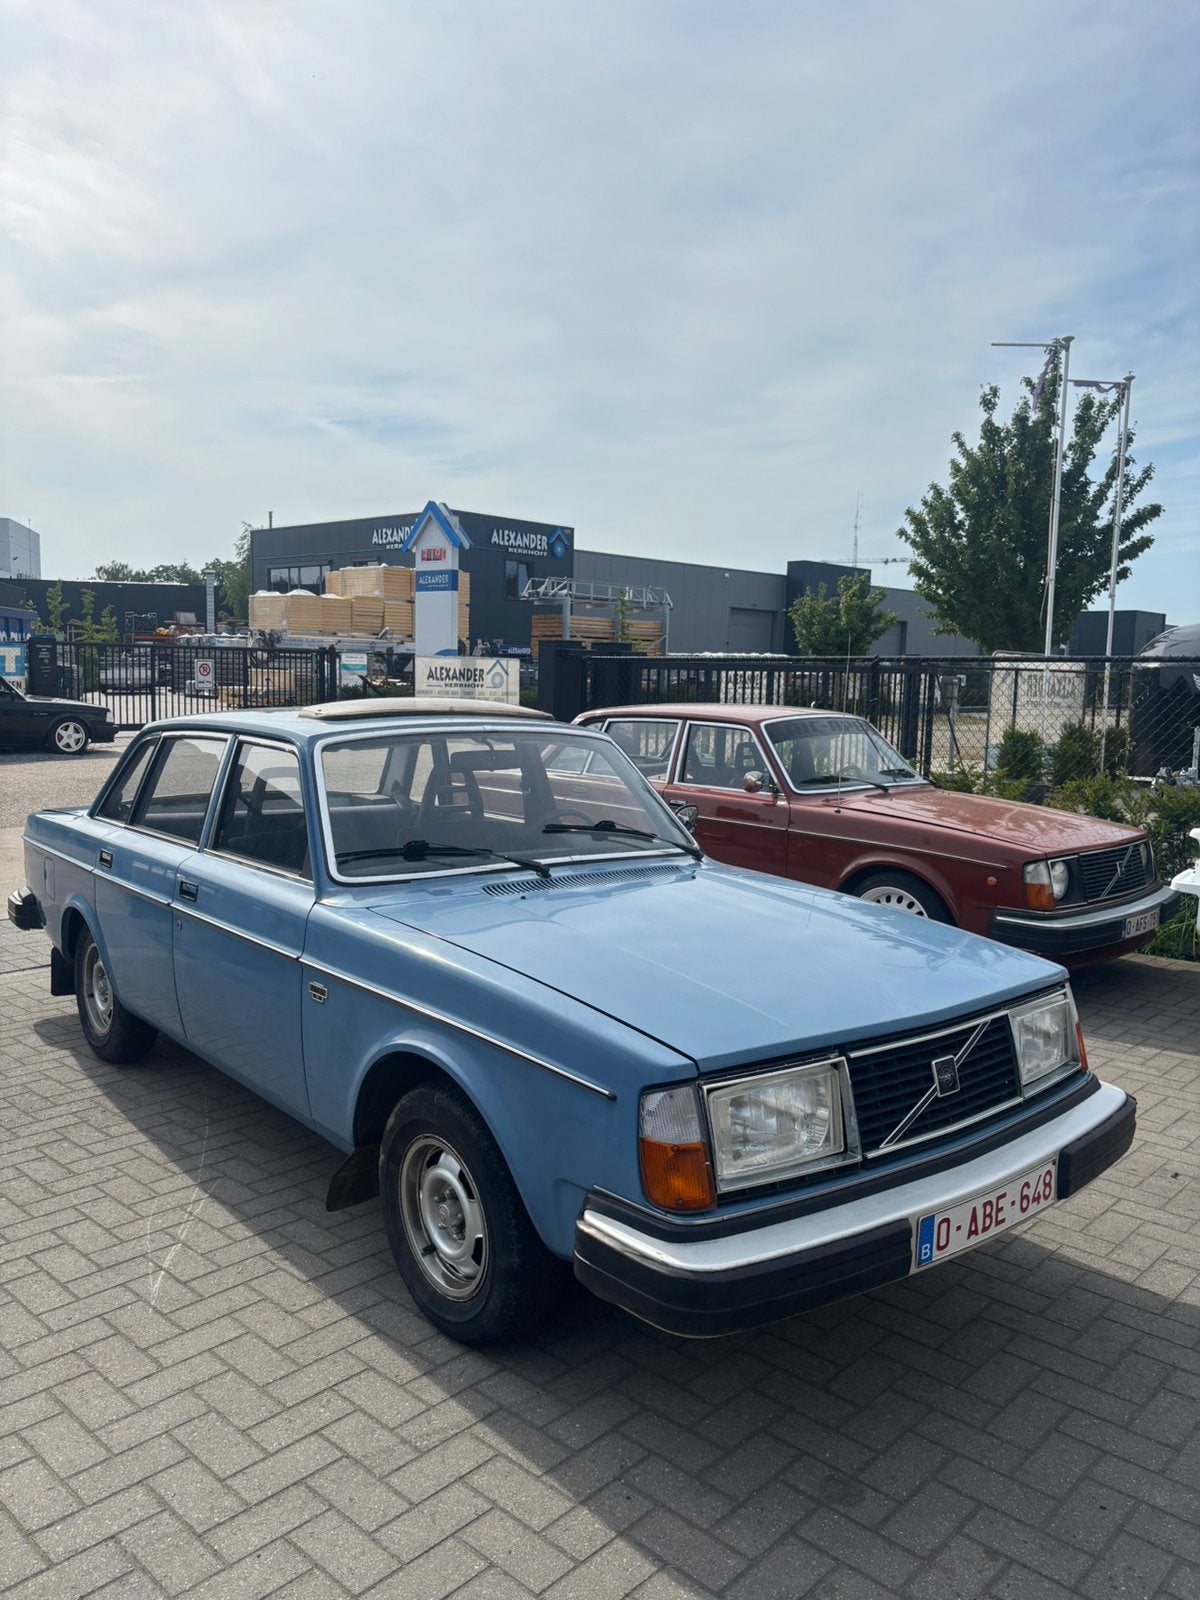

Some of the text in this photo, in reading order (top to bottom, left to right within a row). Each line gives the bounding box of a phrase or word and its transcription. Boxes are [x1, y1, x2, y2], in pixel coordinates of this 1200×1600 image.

[491, 529, 548, 550] ALEXANDER
[508, 547, 548, 557] KERKHOFF
[418, 574, 449, 585] ALEXANDER
[426, 666, 485, 682] ALEXANDER
[921, 1243, 931, 1260] B
